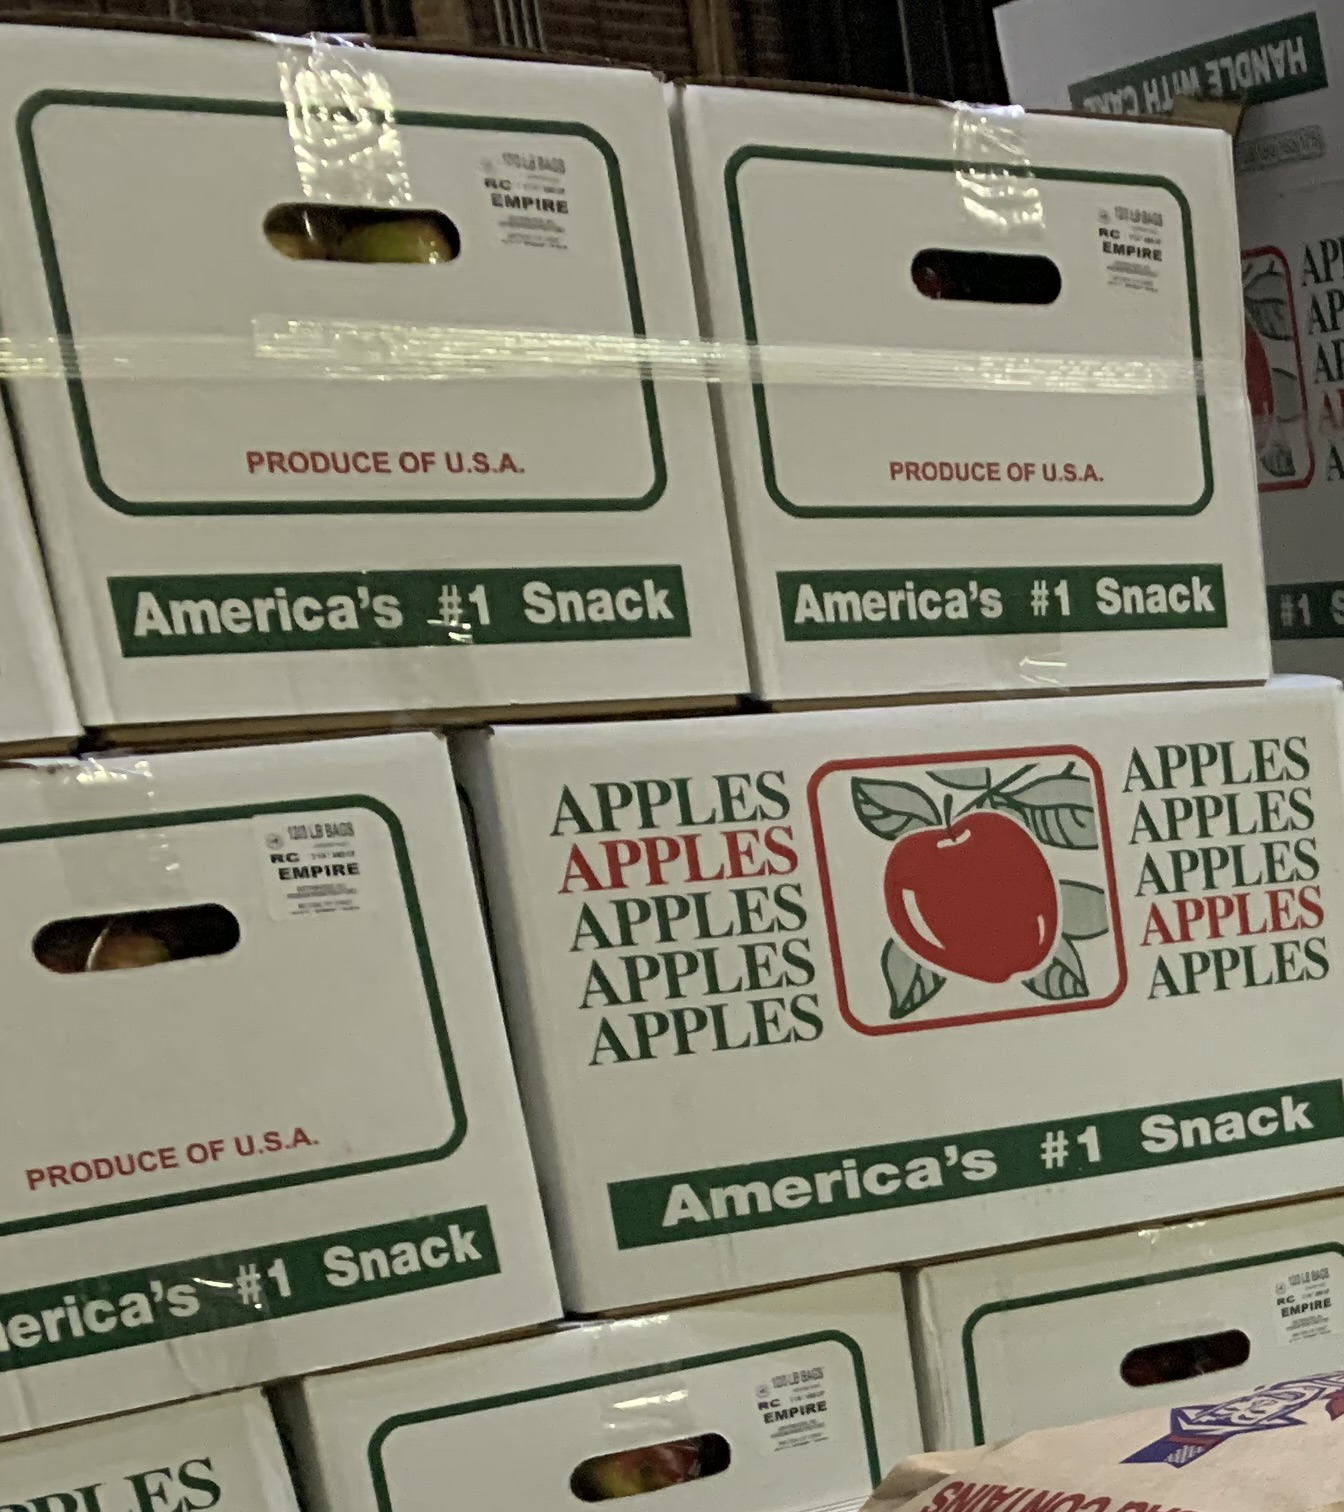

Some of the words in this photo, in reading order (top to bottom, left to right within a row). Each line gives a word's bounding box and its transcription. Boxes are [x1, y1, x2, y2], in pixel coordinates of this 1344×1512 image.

[1205, 36, 1308, 97] HANDLE
[490, 192, 569, 214] EMPIRE
[1098, 227, 1121, 240] RC
[1101, 242, 1163, 262] EMPIRE
[246, 451, 392, 474] PRODUCE
[400, 452, 436, 473] OF
[446, 451, 525, 474] U.S.A.
[889, 461, 1001, 483] PRODUCE
[1007, 462, 1036, 482] OF
[1042, 462, 1104, 482] U.S.A.
[133, 586, 404, 637] America's
[437, 583, 490, 627] #1
[522, 579, 674, 625] Snack
[794, 582, 1003, 625] America's
[1031, 577, 1071, 616] #1
[1095, 576, 1215, 620] Snack
[1120, 735, 1311, 794] APPLES
[548, 769, 792, 838] APPLES
[1127, 788, 1316, 845] APPLES
[270, 852, 300, 863] RC
[279, 863, 360, 880] EMPIRE
[557, 825, 800, 896] APPLES
[1134, 838, 1322, 896] APPLES
[568, 882, 808, 953] APPLES
[1139, 886, 1326, 947] APPLES
[25, 1147, 180, 1192] PRODUCE
[186, 1140, 226, 1166] OF
[234, 1127, 320, 1159] U.S.A.
[660, 1144, 999, 1229] America's
[1039, 1124, 1103, 1172] #1
[1139, 1095, 1314, 1155] Snack
[0, 1280, 201, 1352] erica's
[235, 1258, 294, 1307] #1
[322, 1224, 483, 1289] Snack
[1279, 1297, 1332, 1319] EMPIRE
[763, 1401, 827, 1424] EMPIRE
